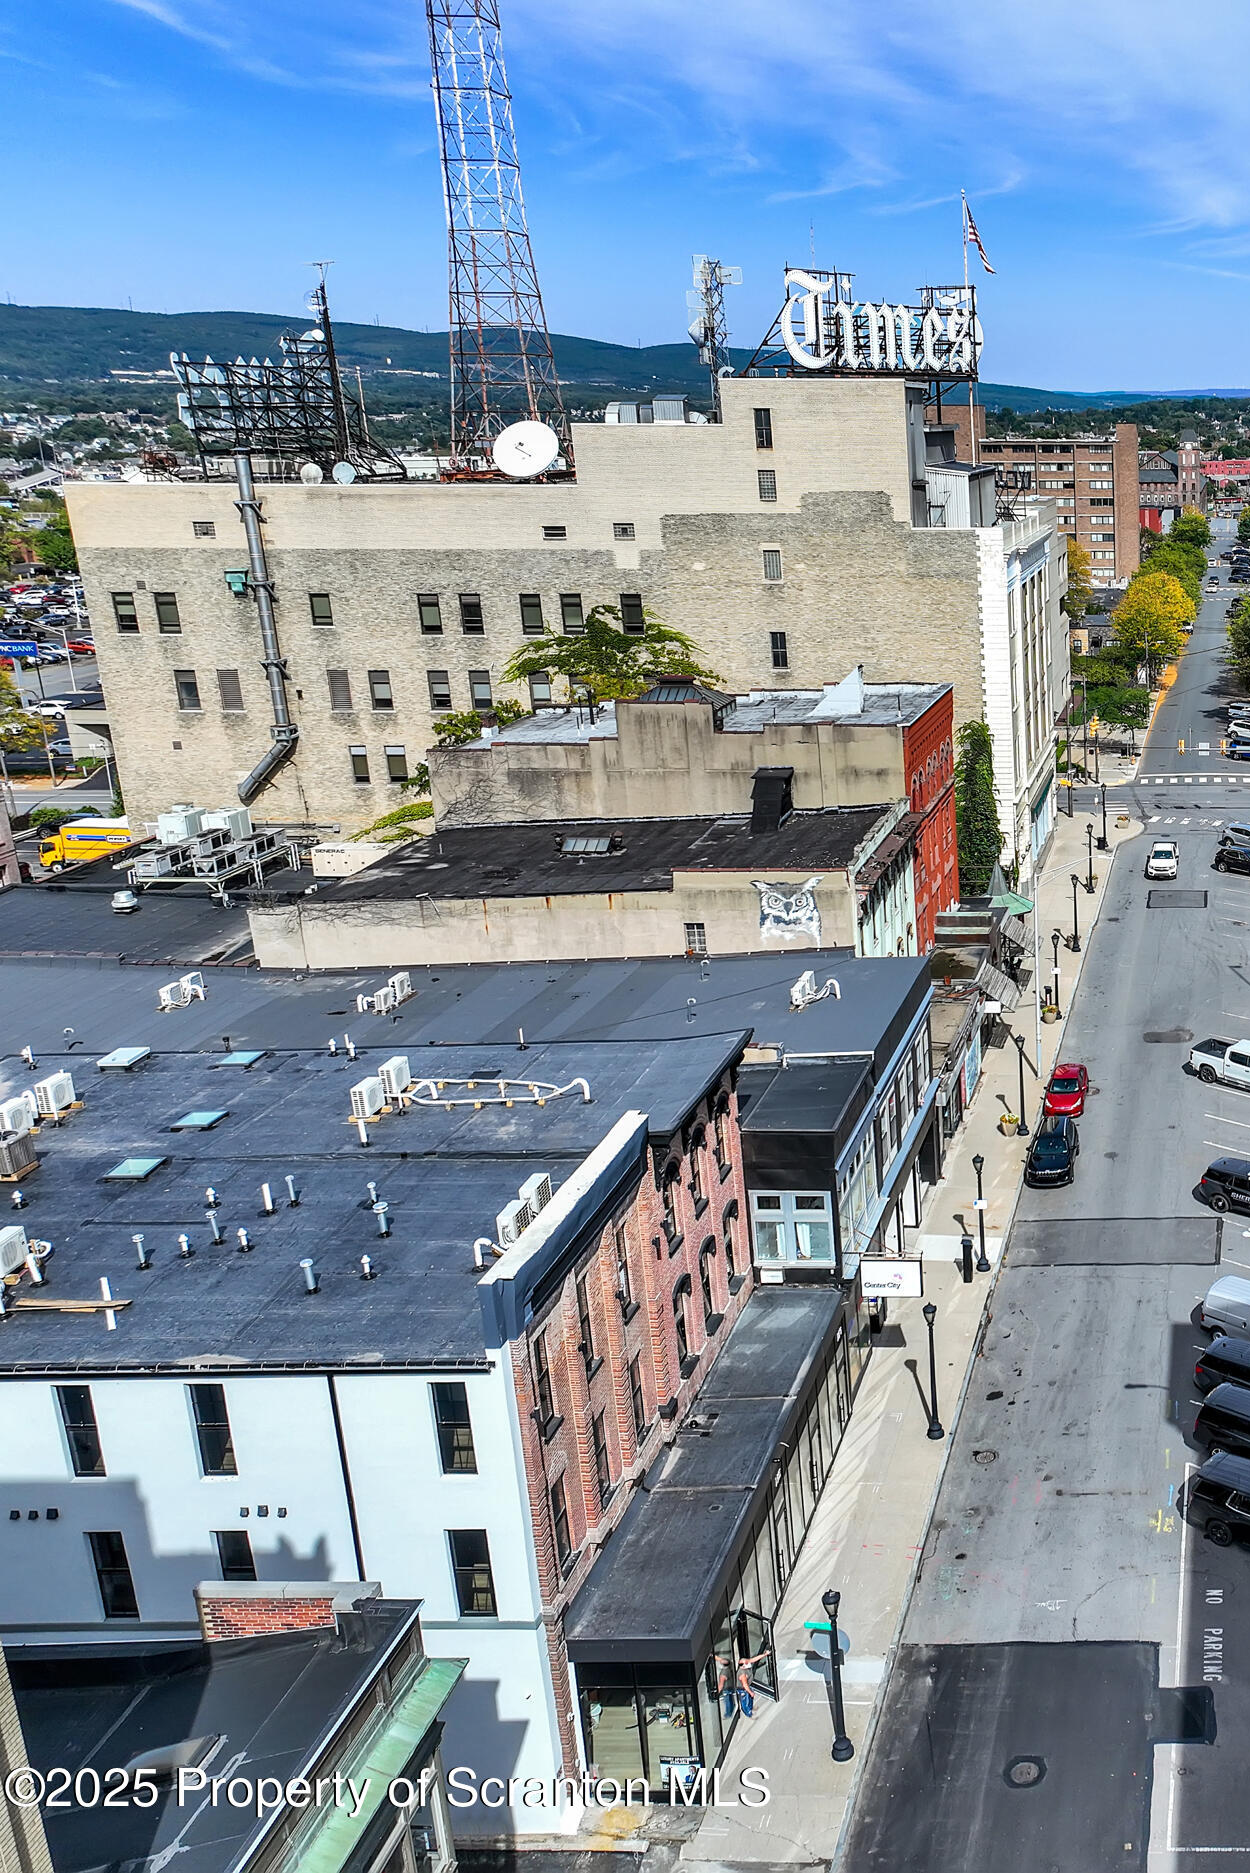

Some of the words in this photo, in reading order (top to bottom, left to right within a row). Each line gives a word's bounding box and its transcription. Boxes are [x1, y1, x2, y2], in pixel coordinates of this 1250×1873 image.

[781, 269, 971, 374] Times
[1205, 1589, 1223, 1604] NO
[1203, 1628, 1223, 1682] PARKING
